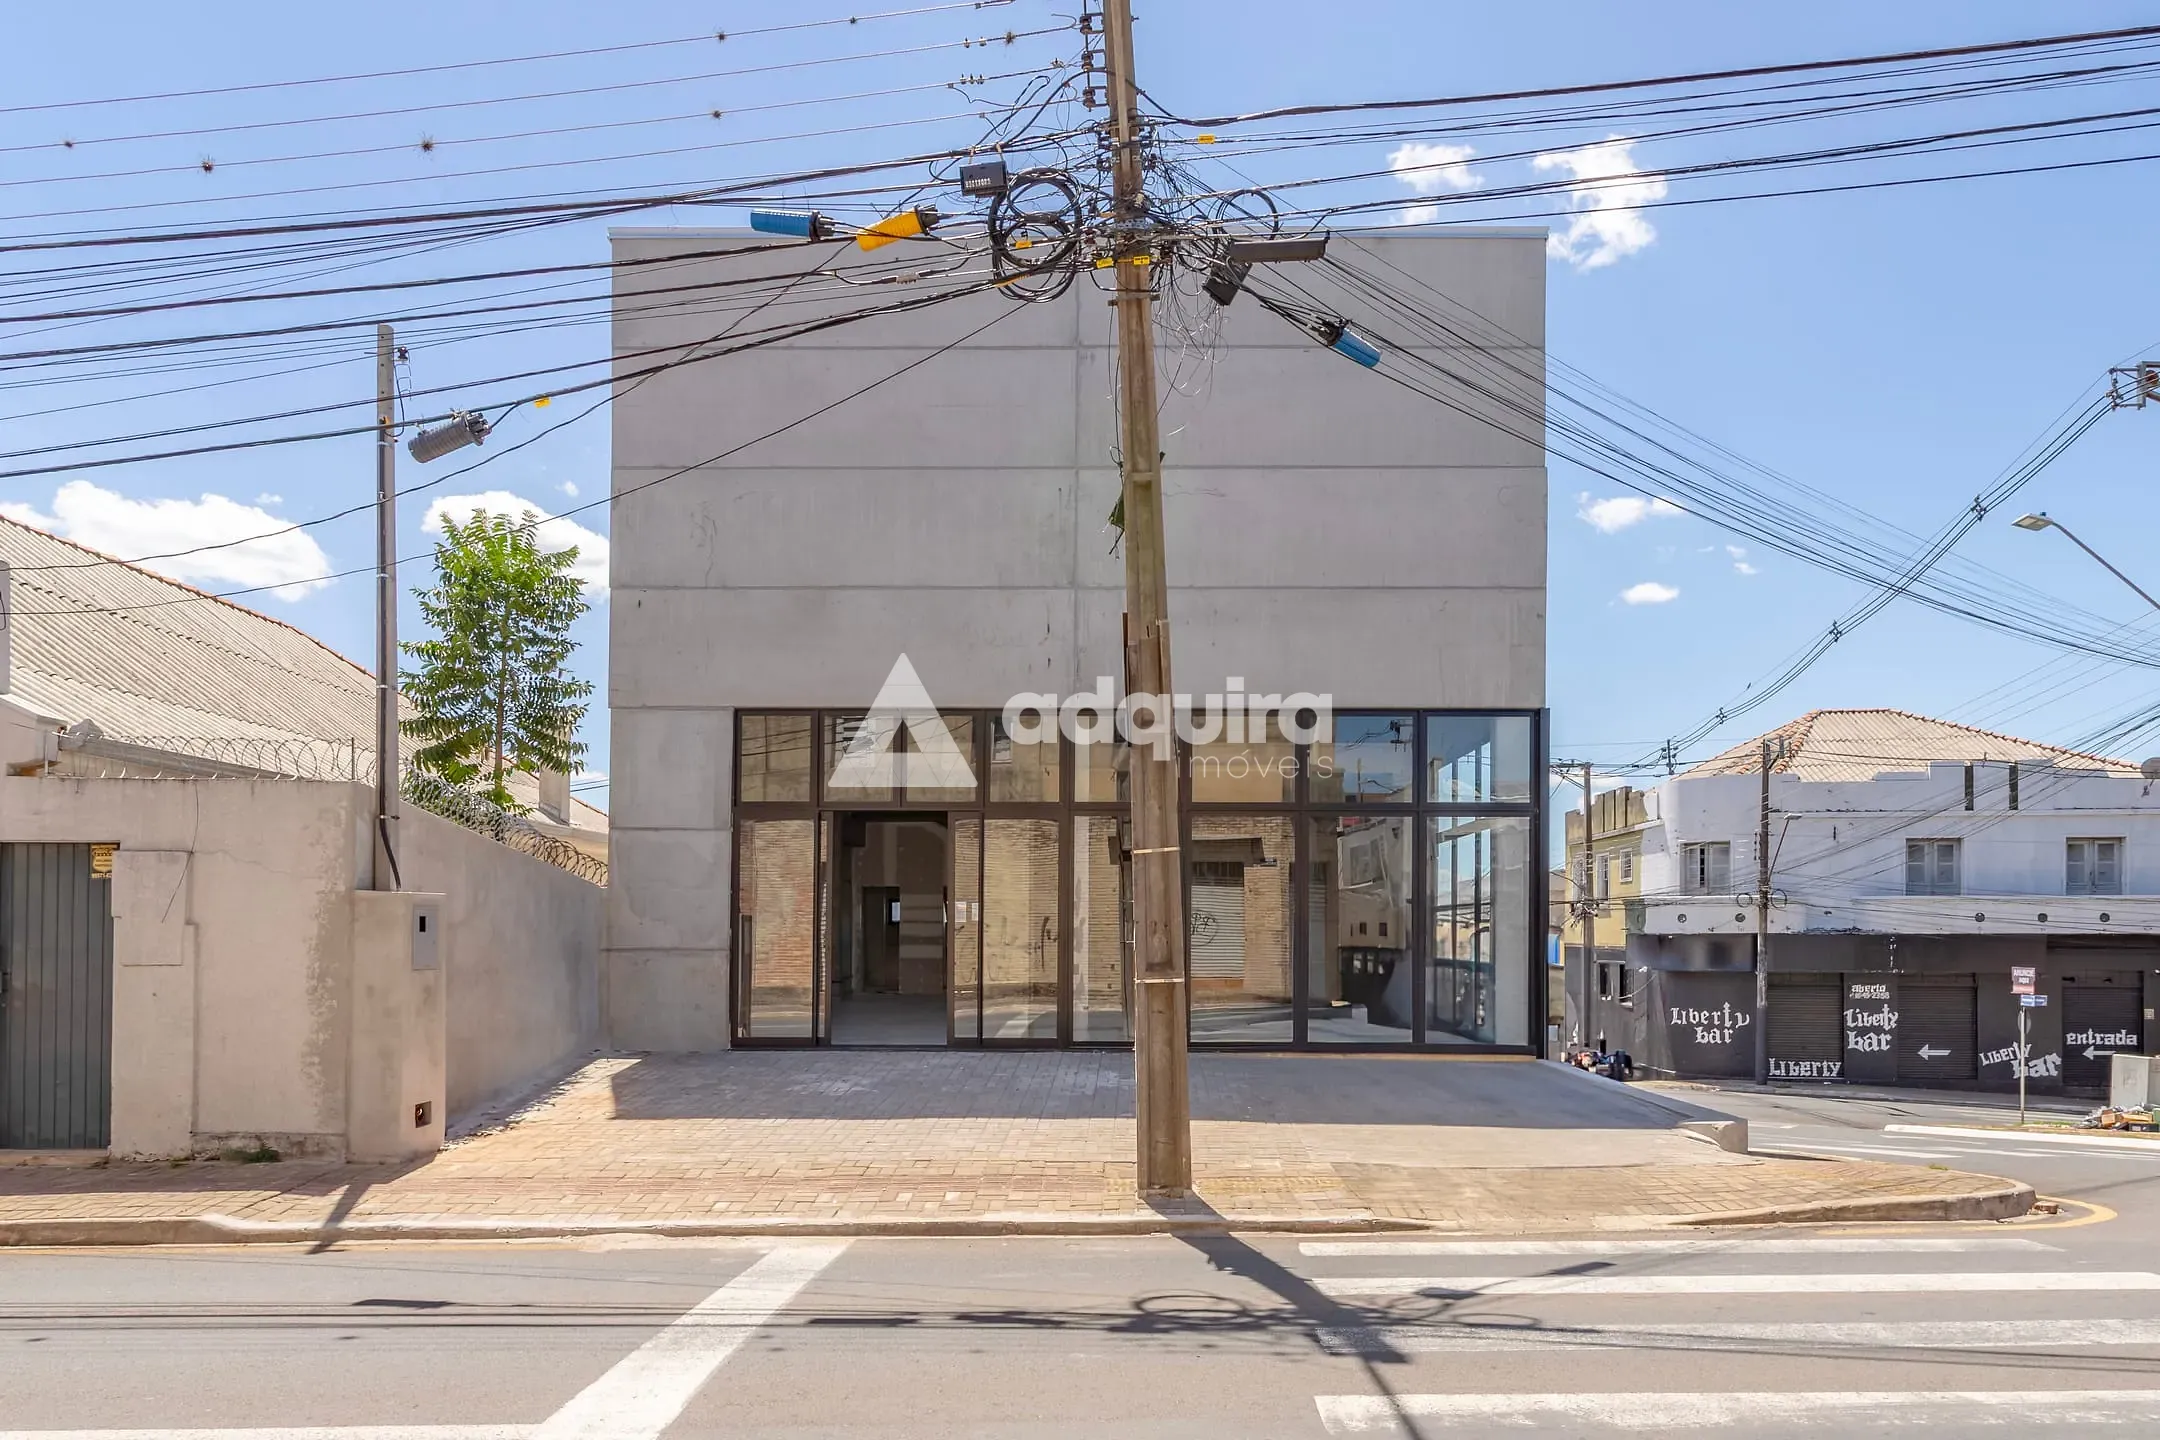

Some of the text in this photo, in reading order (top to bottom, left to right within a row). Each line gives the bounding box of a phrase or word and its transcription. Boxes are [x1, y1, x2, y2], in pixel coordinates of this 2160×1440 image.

[1670, 1001, 1750, 1029] Liberty
[1694, 1026, 1734, 1044] bar
[1846, 1030, 1892, 1052] bar
[2065, 1027, 2138, 1046] entrada
